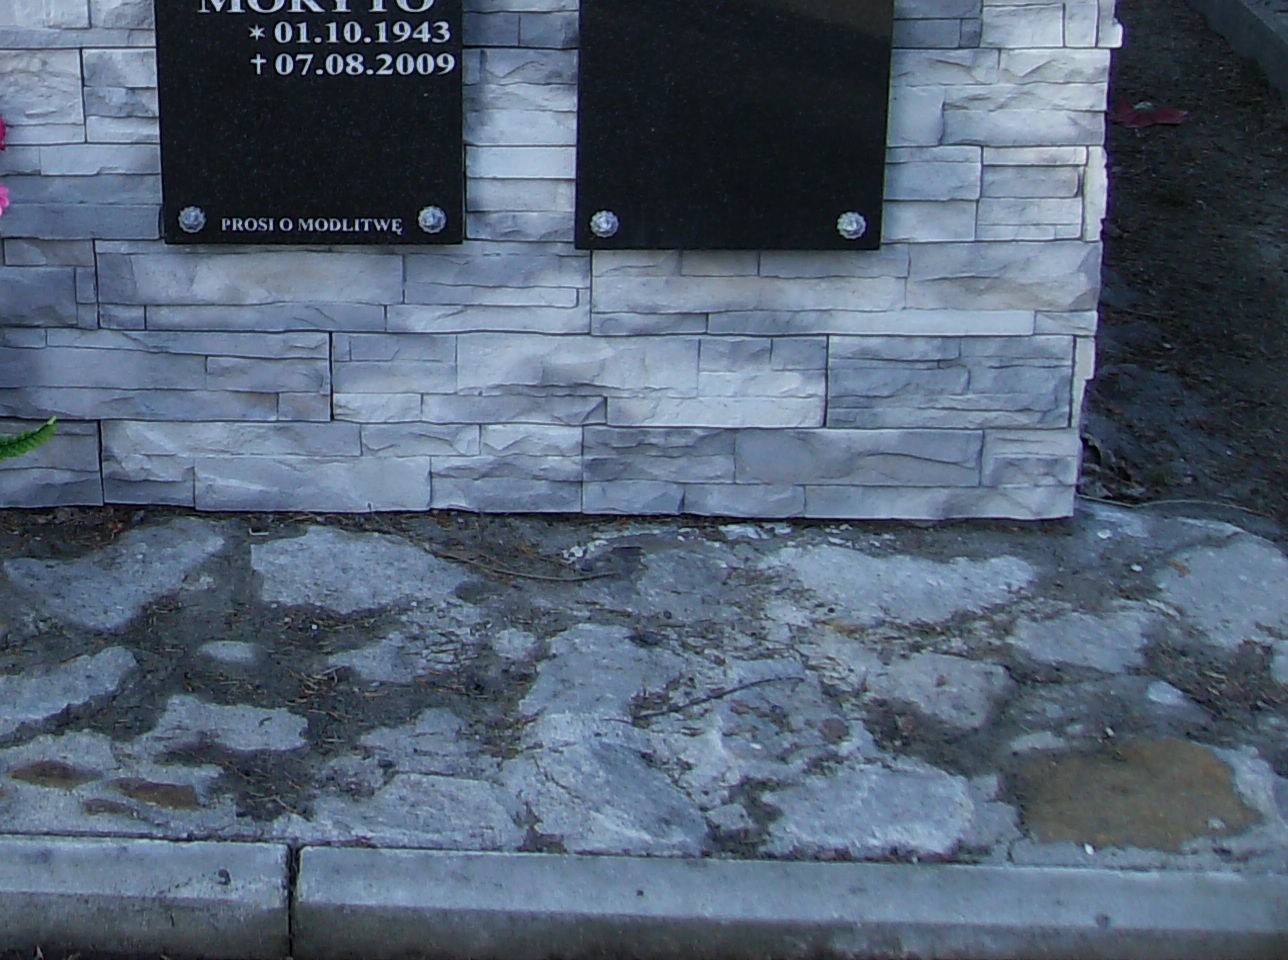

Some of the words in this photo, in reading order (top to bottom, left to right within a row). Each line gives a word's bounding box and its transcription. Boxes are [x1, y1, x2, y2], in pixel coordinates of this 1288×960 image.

[221, 218, 274, 232] PROSI
[279, 218, 293, 232] O
[298, 218, 403, 235] MODLITWĘ
